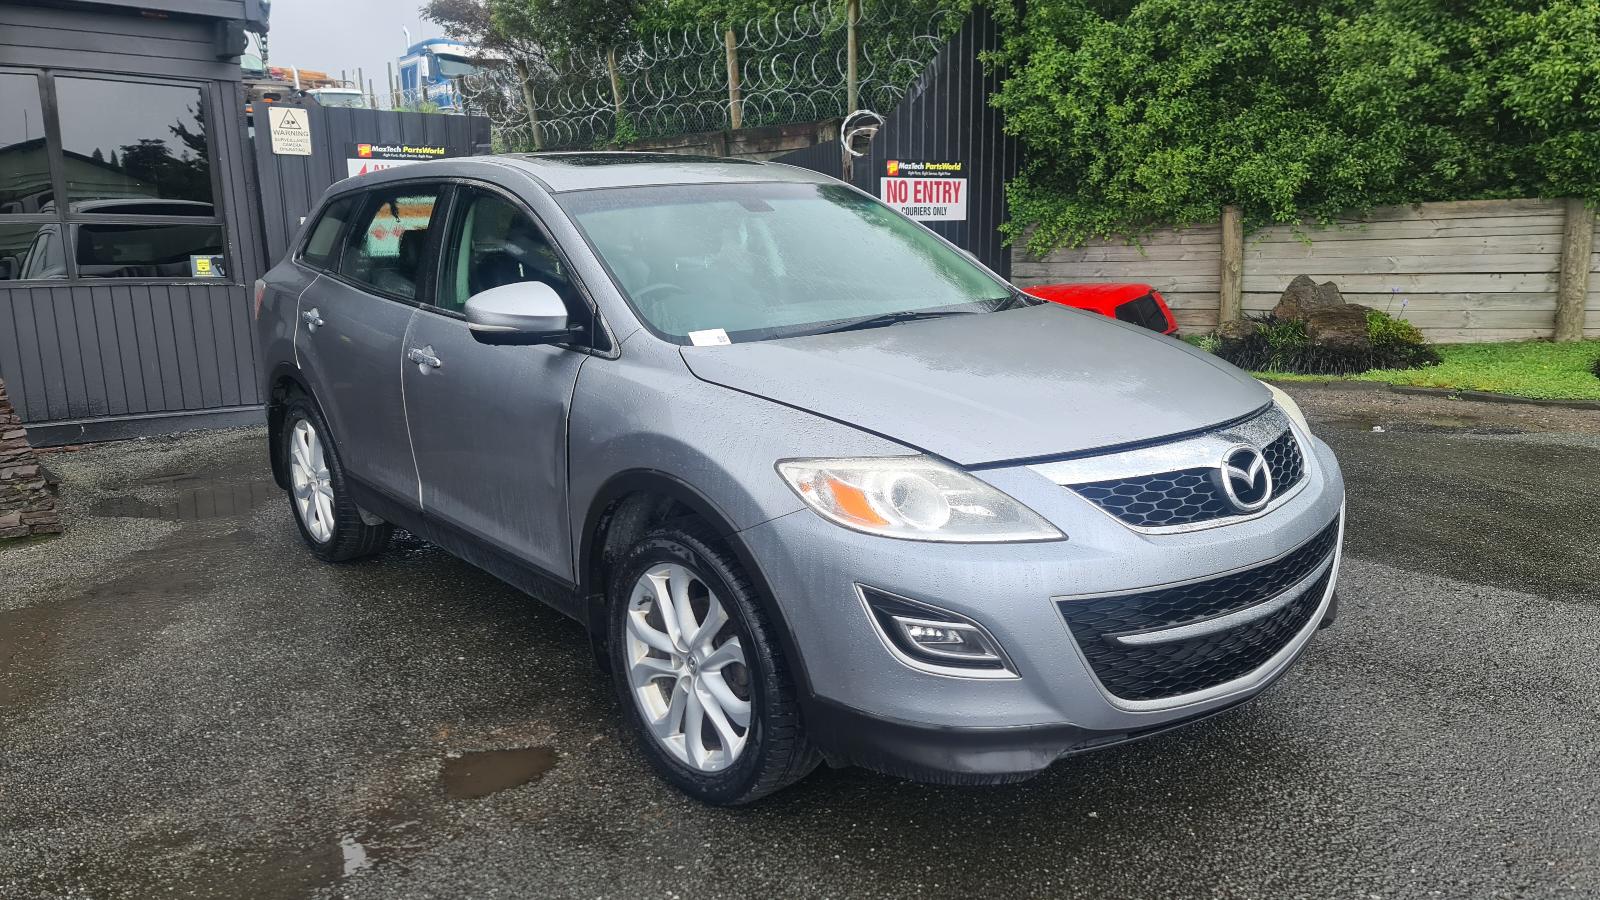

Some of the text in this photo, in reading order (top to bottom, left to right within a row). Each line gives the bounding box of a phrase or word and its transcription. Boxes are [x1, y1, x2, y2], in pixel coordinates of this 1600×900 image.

[403, 146, 445, 155] PartsWorld
[899, 162, 961, 171] MaxTech PartsWorld
[887, 180, 961, 204] NO ENTRY
[902, 206, 947, 216] COURIERS ONLY
